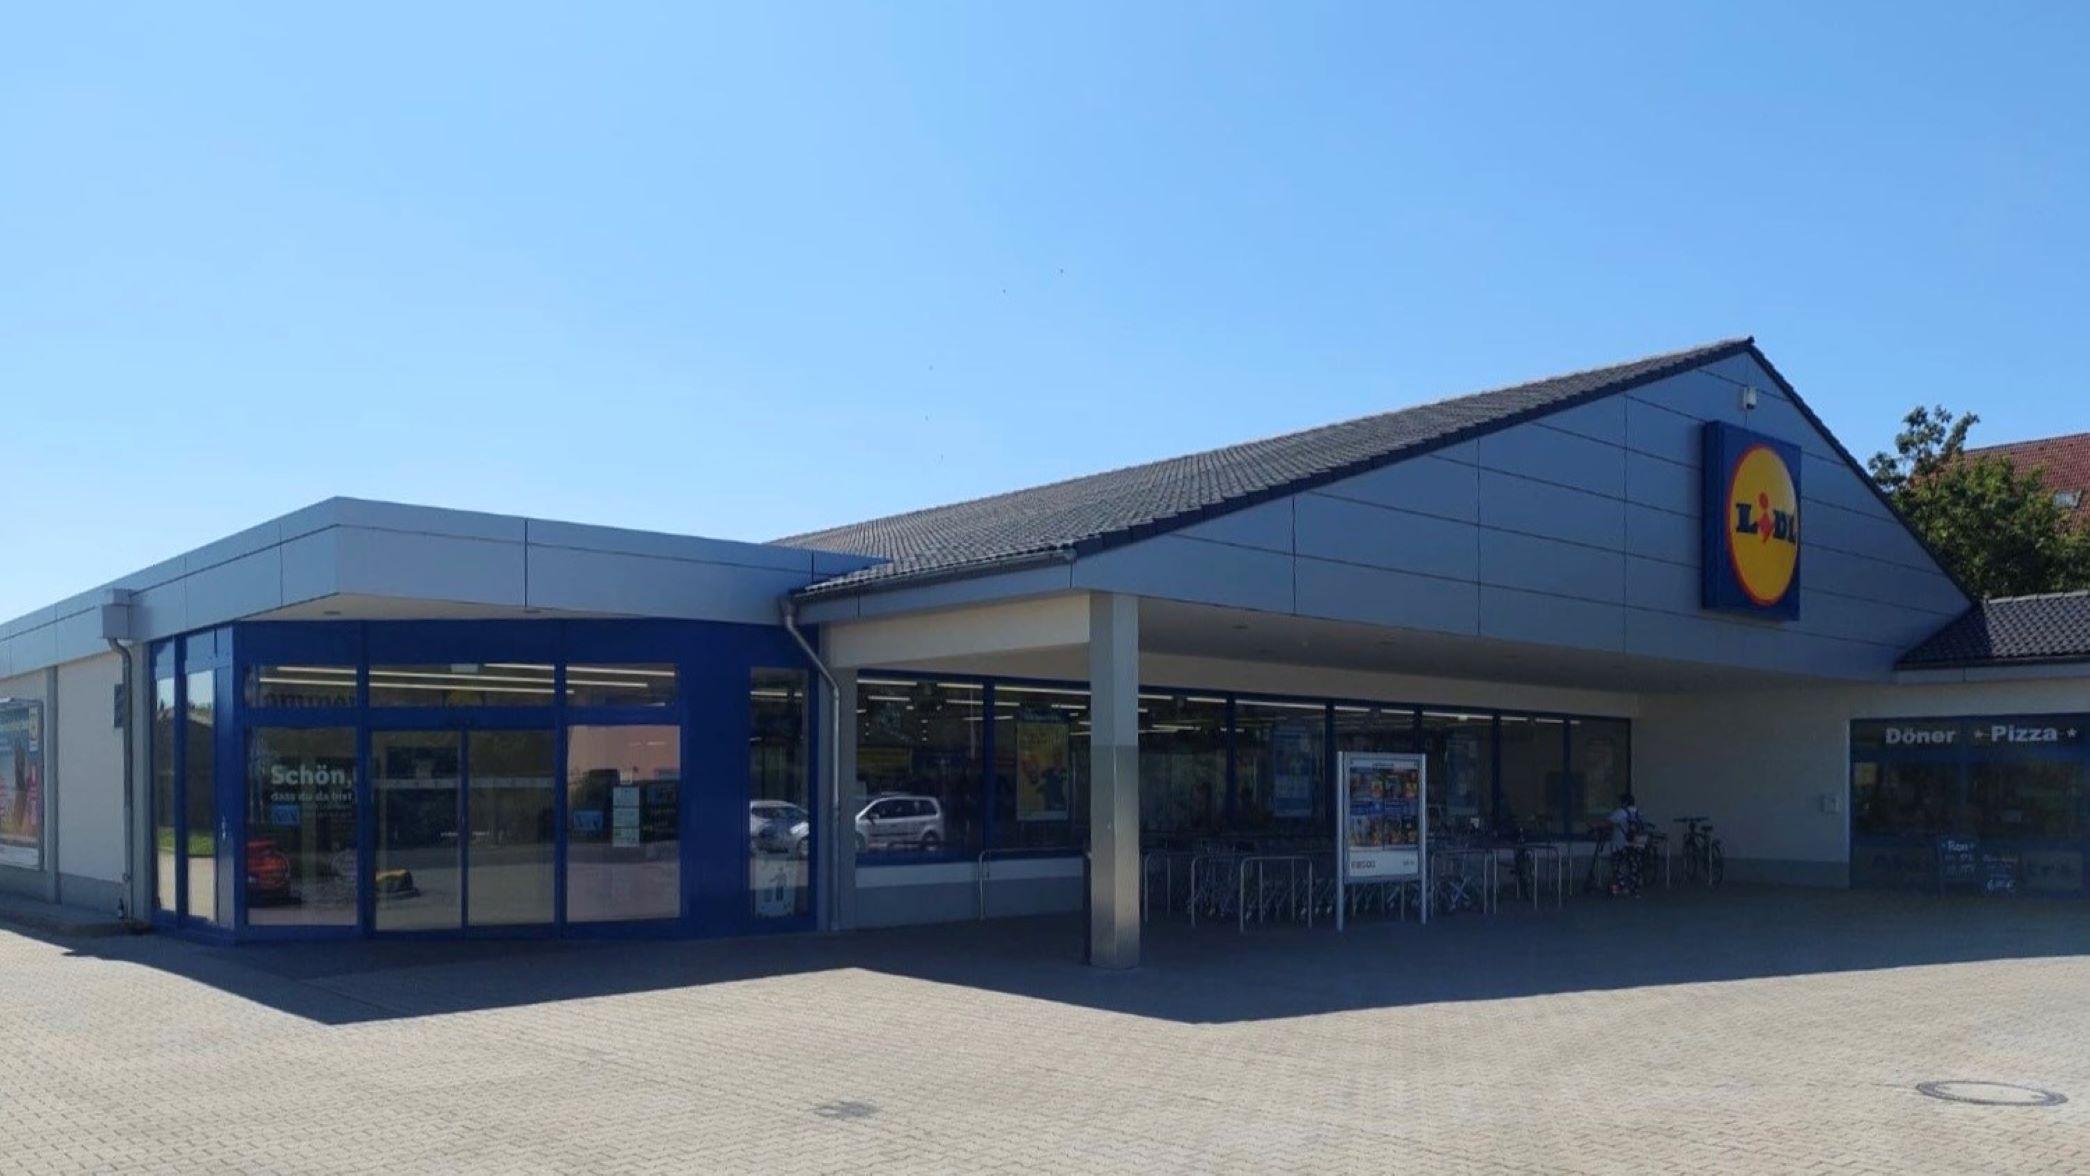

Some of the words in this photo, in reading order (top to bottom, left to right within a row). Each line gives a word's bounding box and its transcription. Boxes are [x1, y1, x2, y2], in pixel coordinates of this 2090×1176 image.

[1885, 727, 1957, 745] Döner
[1990, 724, 2058, 743] Pizza
[270, 763, 353, 789] Schön,
